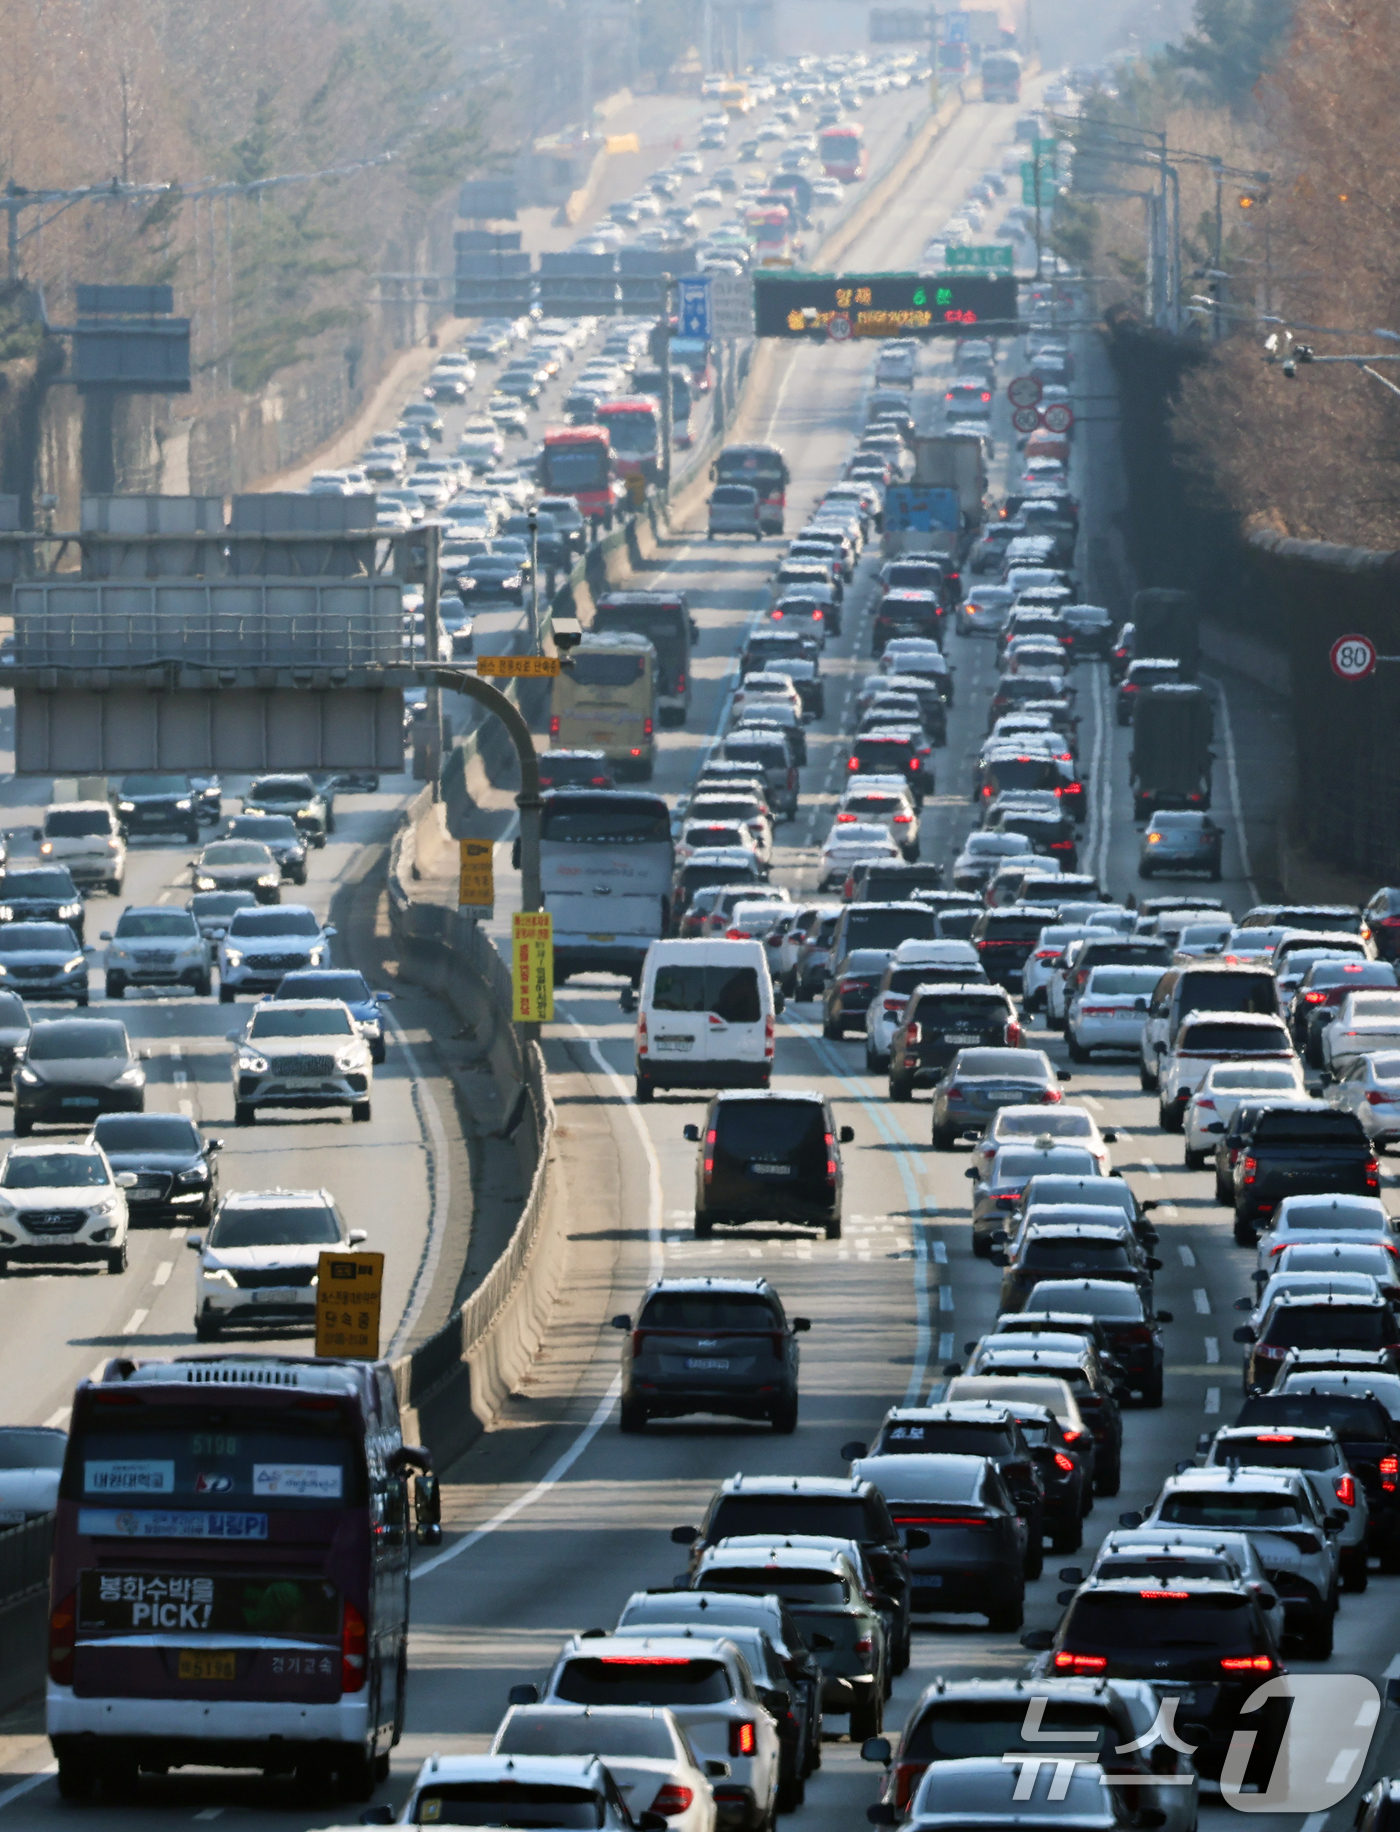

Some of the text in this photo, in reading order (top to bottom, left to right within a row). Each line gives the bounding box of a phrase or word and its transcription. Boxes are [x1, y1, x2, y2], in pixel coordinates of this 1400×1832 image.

[1341, 646, 1367, 668] 80
[99, 1575, 215, 1602] 봉화수박을
[132, 1602, 213, 1629] PICK!
[271, 1656, 333, 1675] 경기고속
